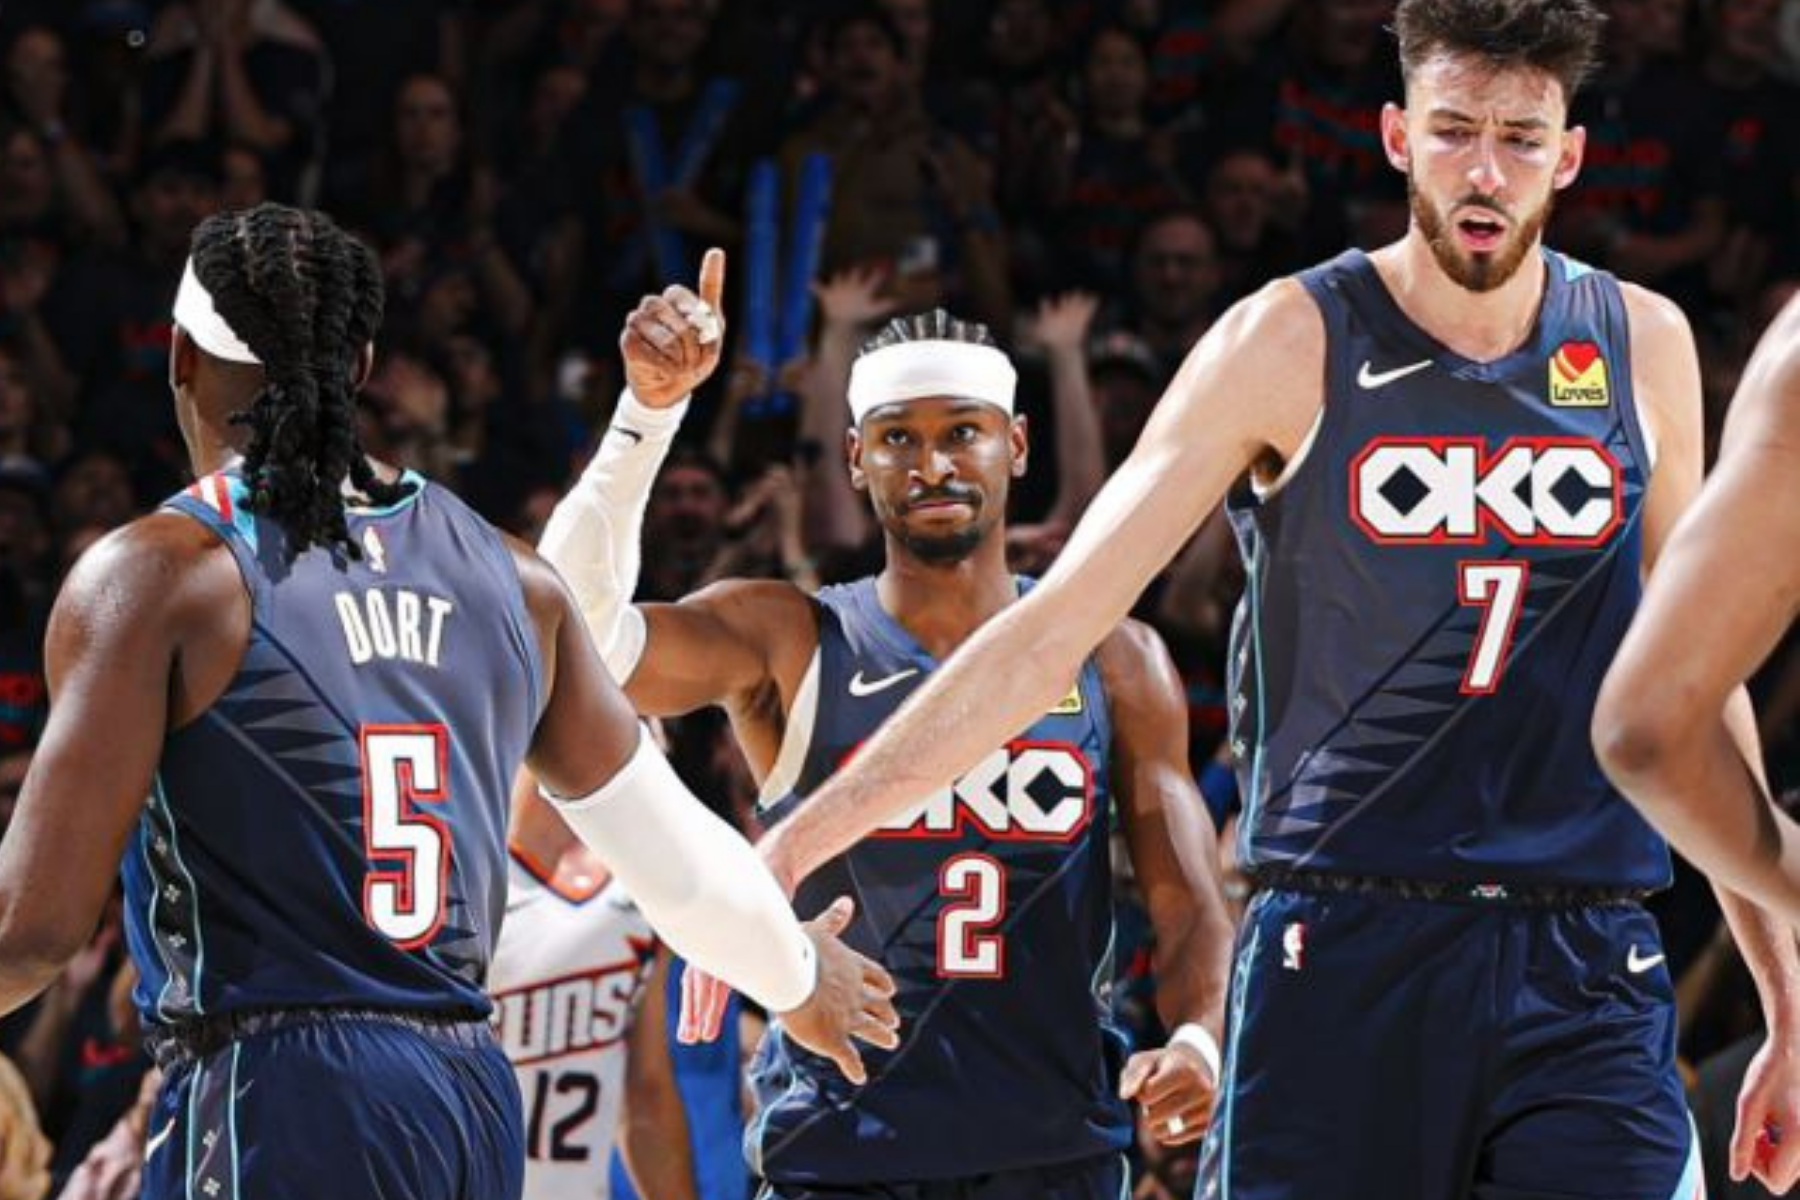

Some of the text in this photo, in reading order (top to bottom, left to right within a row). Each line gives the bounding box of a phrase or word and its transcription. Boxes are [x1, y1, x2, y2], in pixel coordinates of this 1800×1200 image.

[1350, 437, 1624, 544] OKC
[335, 588, 452, 667] DORT
[1457, 560, 1529, 694] 7
[361, 722, 450, 949] 5
[862, 740, 1095, 842] KC
[937, 852, 1006, 978] 2
[527, 1070, 599, 1162] 12
